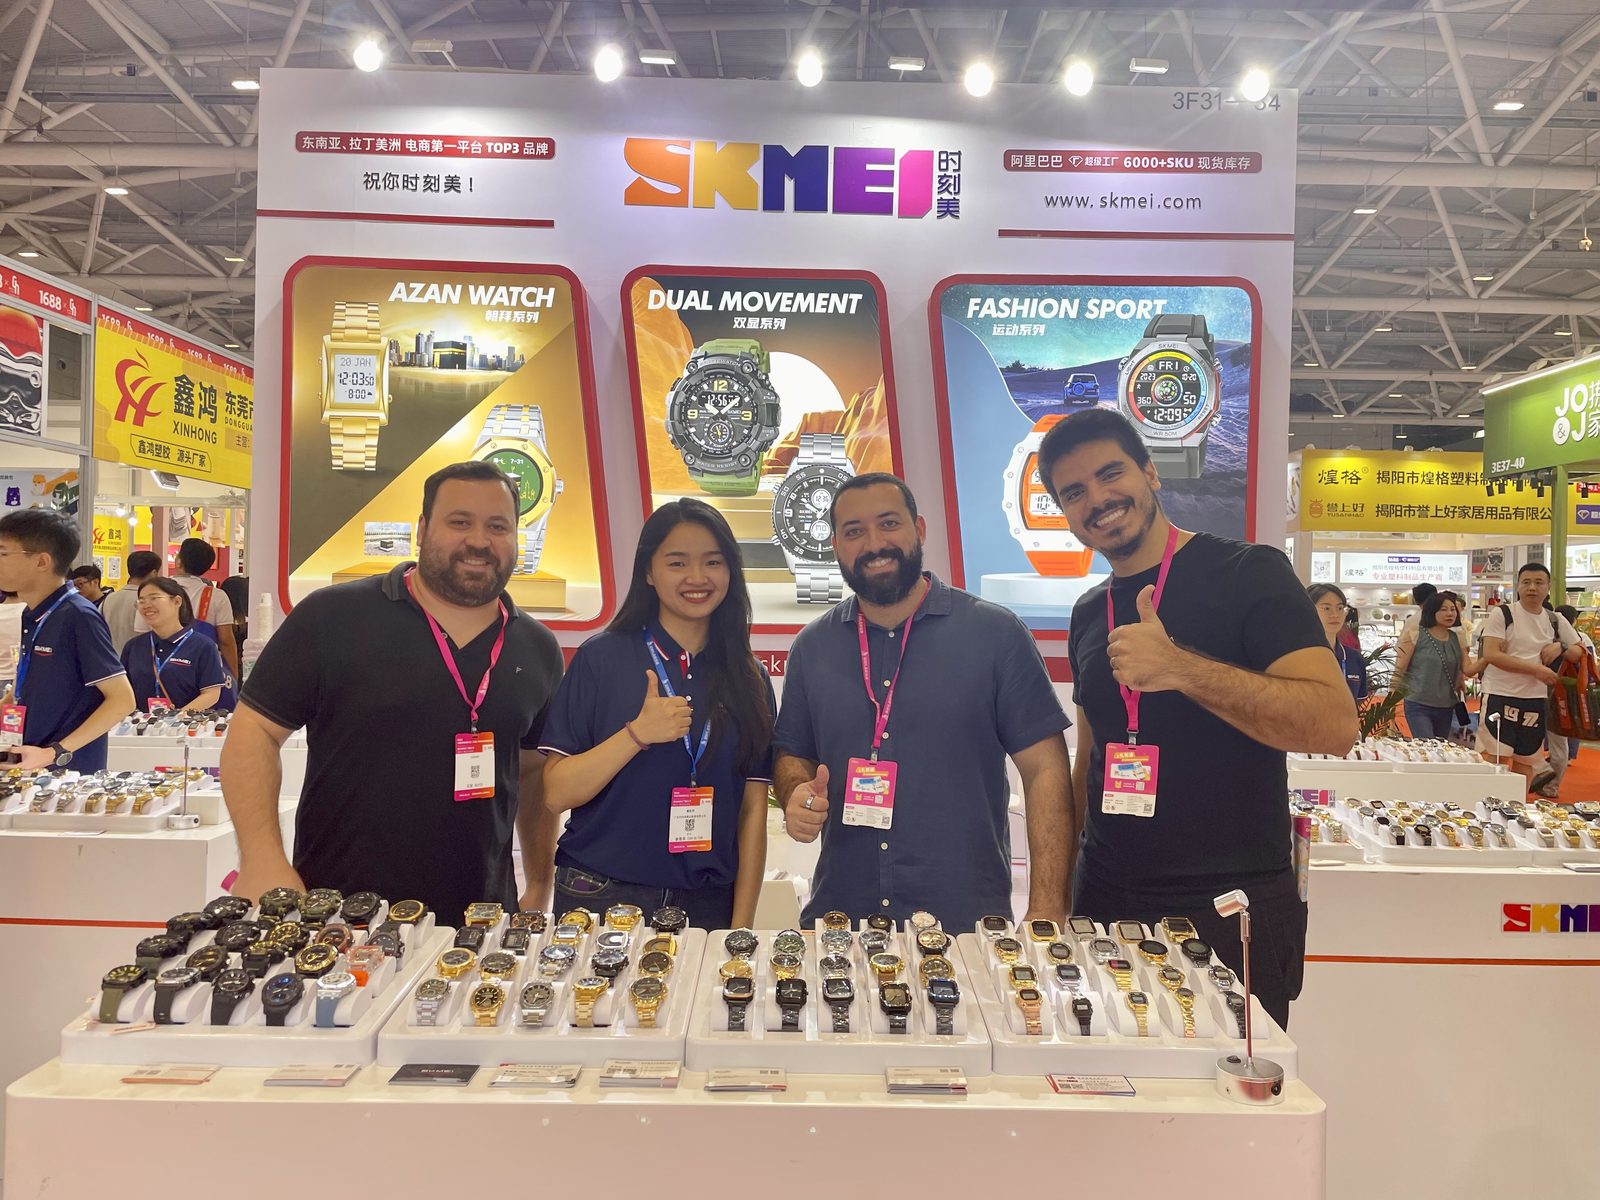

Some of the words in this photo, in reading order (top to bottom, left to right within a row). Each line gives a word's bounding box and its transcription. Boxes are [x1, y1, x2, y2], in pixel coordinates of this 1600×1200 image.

[302, 136, 401, 152] 东南亚、拉丁美洲
[405, 138, 482, 154] 电商第一平台
[486, 142, 519, 153] TOP3
[523, 142, 549, 155] 品牌
[1011, 155, 1063, 168] 阿里巴巴
[1085, 157, 1119, 167] 超级工厂
[1123, 157, 1194, 168] 6000+SKU
[1197, 156, 1251, 170] 现货库存
[624, 137, 934, 219] SKMEI
[936, 150, 962, 220] 时刻美
[39, 290, 61, 310] 1688
[388, 282, 462, 304] AZAN
[468, 285, 555, 308] WATCH
[648, 290, 713, 311] DUAL
[718, 291, 863, 314] MOVEMENT
[485, 310, 539, 323] 朝拜系列
[966, 298, 1080, 319] FASHION
[1085, 299, 1168, 319] SPORT
[733, 317, 786, 330] 双显系列
[992, 324, 1045, 336] 运动系列
[1159, 361, 1179, 370] FRI
[713, 379, 728, 391] 12
[174, 374, 217, 424] 鑫鸿
[1555, 384, 1588, 416] JO
[687, 409, 698, 419] 9
[741, 410, 752, 420] 3
[1154, 408, 1182, 421] 12:09
[173, 420, 217, 444] XINHONG
[138, 440, 170, 459] 鑫鸿塑胶
[177, 449, 206, 467] 源头厂家
[1491, 457, 1525, 473] 3E37-40
[1318, 469, 1362, 485] 煌格
